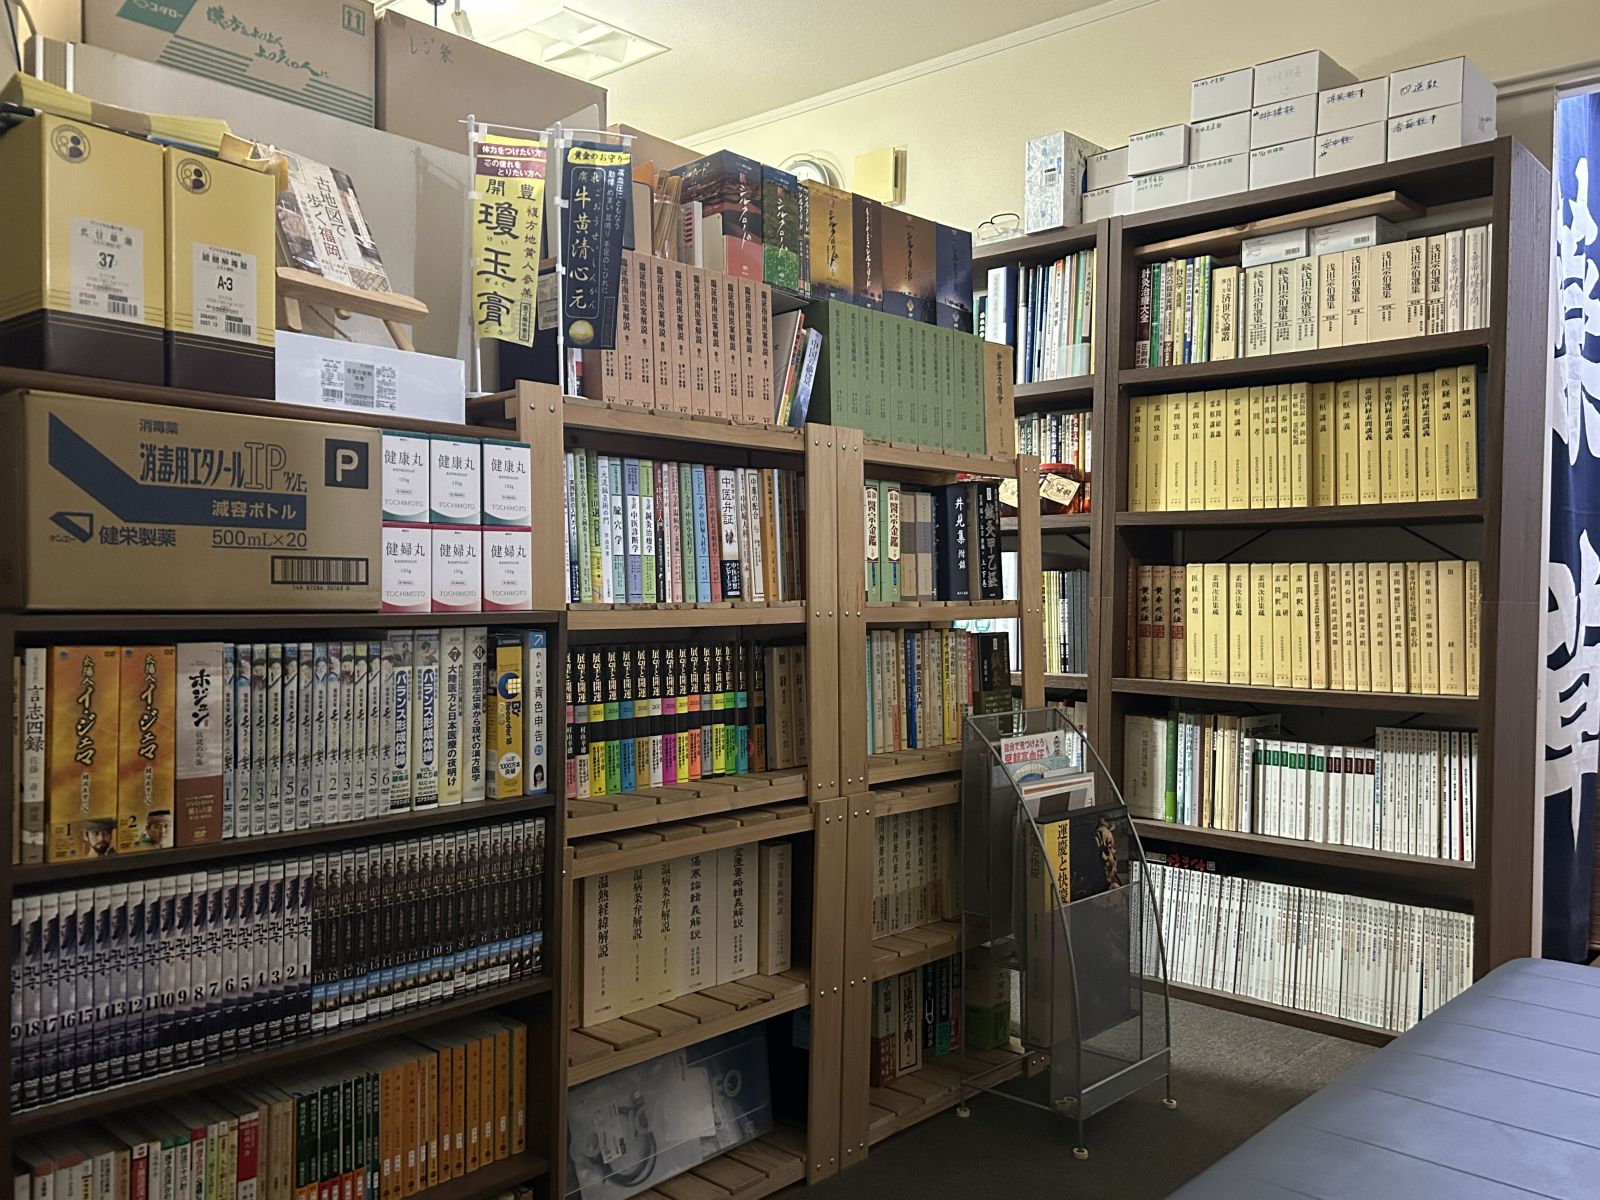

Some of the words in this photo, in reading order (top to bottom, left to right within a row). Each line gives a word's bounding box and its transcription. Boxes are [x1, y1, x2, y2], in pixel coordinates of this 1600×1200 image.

[1400, 80, 1439, 96] 四逆散
[482, 145, 542, 157] 体力をつけたい方
[498, 168, 543, 178] とりたい方へ
[317, 176, 348, 238] 古地図で
[738, 184, 751, 249] シルクロード
[307, 193, 343, 261] 歩く福岡
[776, 198, 789, 258] シルクロード
[569, 186, 591, 310] 牛黄清心元
[98, 252, 115, 269] 37
[217, 276, 234, 291] A-3
[139, 418, 178, 435] 消毒薬
[336, 449, 359, 483] P
[384, 449, 424, 467] 健康丸
[438, 454, 475, 471] 健康丸
[491, 458, 526, 474] 健康丸
[384, 499, 424, 508] TOCHIMOTO
[439, 502, 476, 510] TOCHIMOTO
[492, 504, 527, 512] TOCHIMOTO
[721, 476, 734, 525] 中医弁証
[212, 500, 297, 520] 減容ボトル
[99, 526, 176, 547] 健栄製薬
[630, 511, 640, 553] 中医診断学
[645, 512, 653, 553] 鍼灸治療学
[386, 541, 425, 557] 健婦丸
[440, 543, 477, 558] 健婦丸
[491, 543, 527, 558] 健婦丸
[386, 590, 426, 598] TOCHIMOTO
[440, 590, 477, 598] TOCHIMOTO
[189, 668, 211, 727] ホジュン
[25, 685, 45, 752] 言志四録
[422, 669, 434, 765] バランス形成体操
[447, 664, 457, 786] 大陸医方と日本医療の夜明け
[472, 662, 481, 782] 西洋医学伝来から現代の漢方医学
[1004, 738, 1045, 752] 自分で見つけよう
[1004, 749, 1045, 764] 早朝高血圧
[316, 780, 322, 792] 1
[329, 778, 337, 790] 2
[344, 778, 350, 791] 3
[355, 777, 364, 789] 4
[370, 774, 377, 786] 5
[382, 773, 390, 785] 6
[225, 788, 231, 801] 1
[241, 789, 249, 801] 2
[257, 789, 264, 801] 3
[270, 786, 278, 798] 4
[287, 782, 294, 794] 5
[301, 785, 309, 797] 6
[127, 815, 137, 828] 2
[271, 970, 280, 985] 3
[286, 965, 296, 980] 2
[301, 963, 308, 977] 1
[225, 978, 235, 993] 6
[240, 976, 250, 991] 5
[256, 972, 264, 987] 4
[177, 989, 188, 1005] 9
[193, 985, 204, 1001] 8
[209, 982, 219, 998] 7
[128, 999, 143, 1015] 12
[146, 996, 159, 1012] 11
[160, 992, 175, 1008] 10
[78, 1008, 93, 1025] 15
[95, 1005, 109, 1022] 14
[111, 1002, 126, 1018] 13
[24, 1020, 41, 1037] 18
[42, 1017, 58, 1034] 17
[60, 1012, 76, 1030] 16
